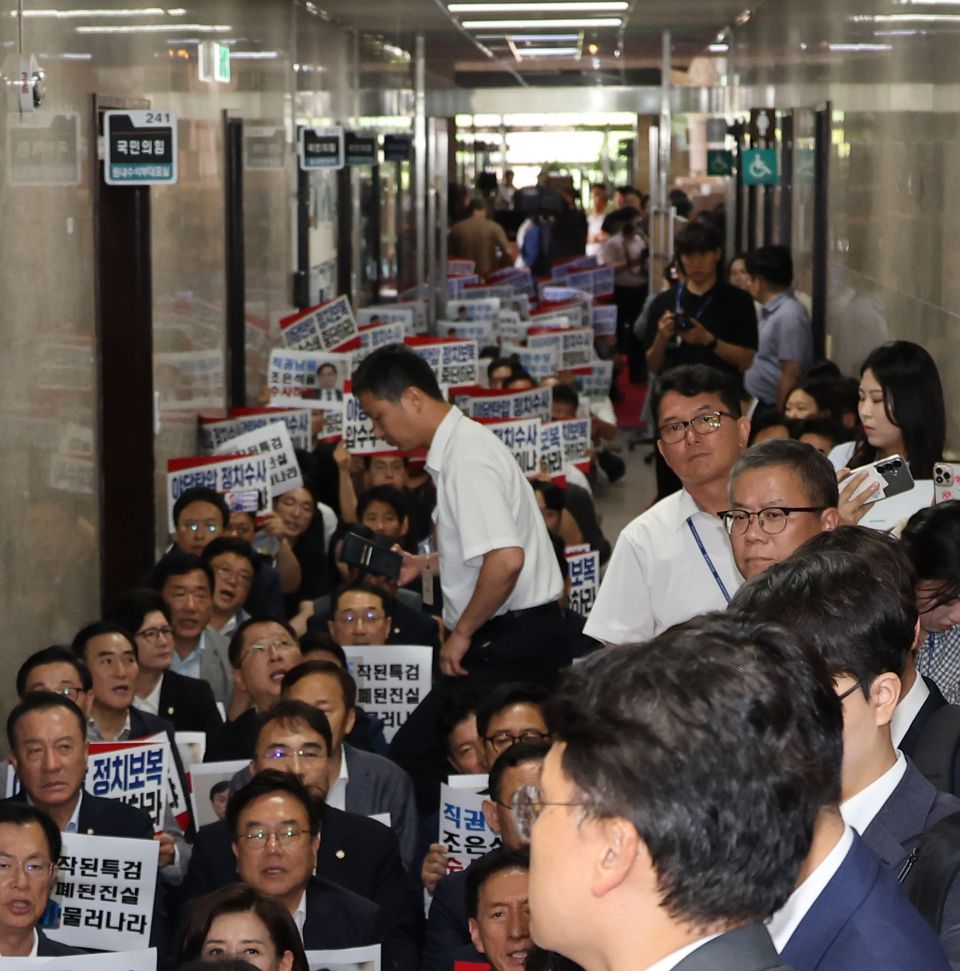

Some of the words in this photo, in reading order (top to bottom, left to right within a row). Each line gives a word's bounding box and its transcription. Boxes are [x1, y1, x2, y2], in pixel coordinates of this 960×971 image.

[146, 113, 170, 124] 241
[117, 139, 165, 155] 국민의힘
[222, 460, 267, 490] 정치수사
[357, 664, 419, 681] 작된특검
[93, 748, 164, 796] 정치보복
[57, 856, 142, 881] 작된특검
[55, 882, 139, 905] 폐된진실
[62, 906, 147, 935] 물러나라
